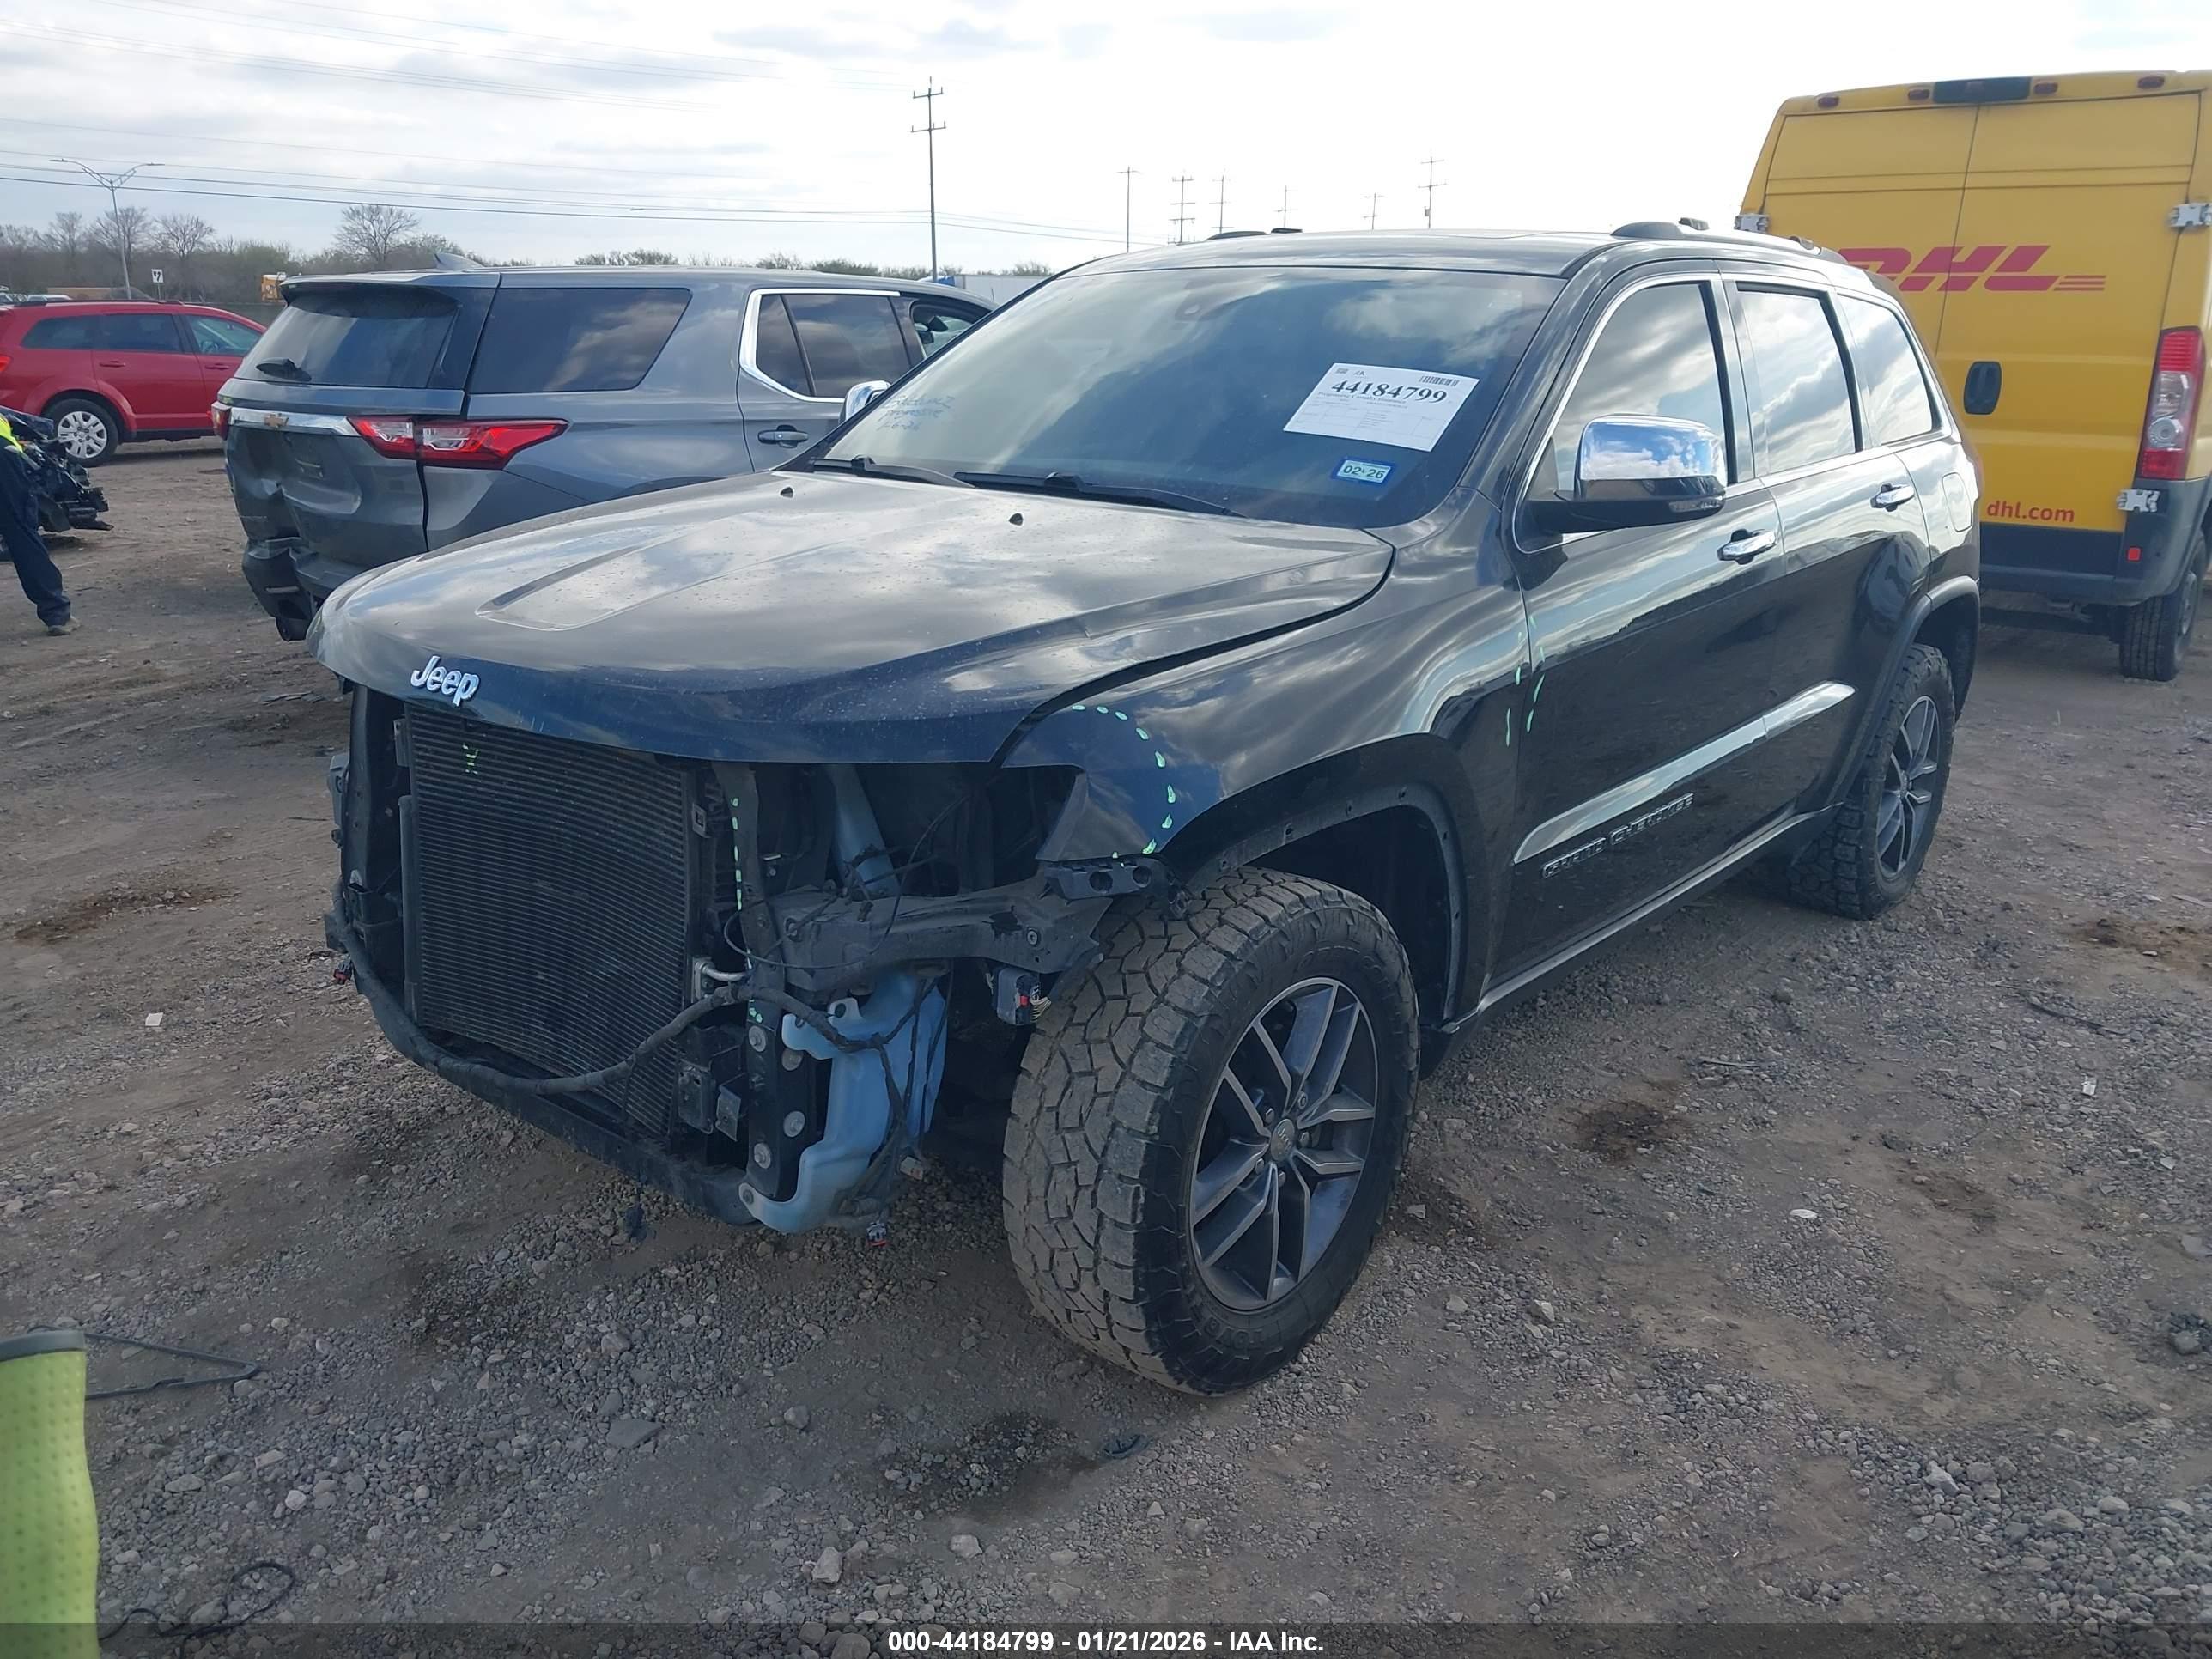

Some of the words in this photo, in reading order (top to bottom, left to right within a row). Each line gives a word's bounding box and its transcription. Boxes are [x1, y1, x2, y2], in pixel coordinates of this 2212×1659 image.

[1837, 245, 2059, 292] DHL
[1331, 380, 1447, 403] 44184799
[1343, 465, 1362, 475] 02
[1366, 469, 1385, 478] 26
[1987, 501, 2075, 522] dhl.com
[410, 655, 480, 707] Jeep
